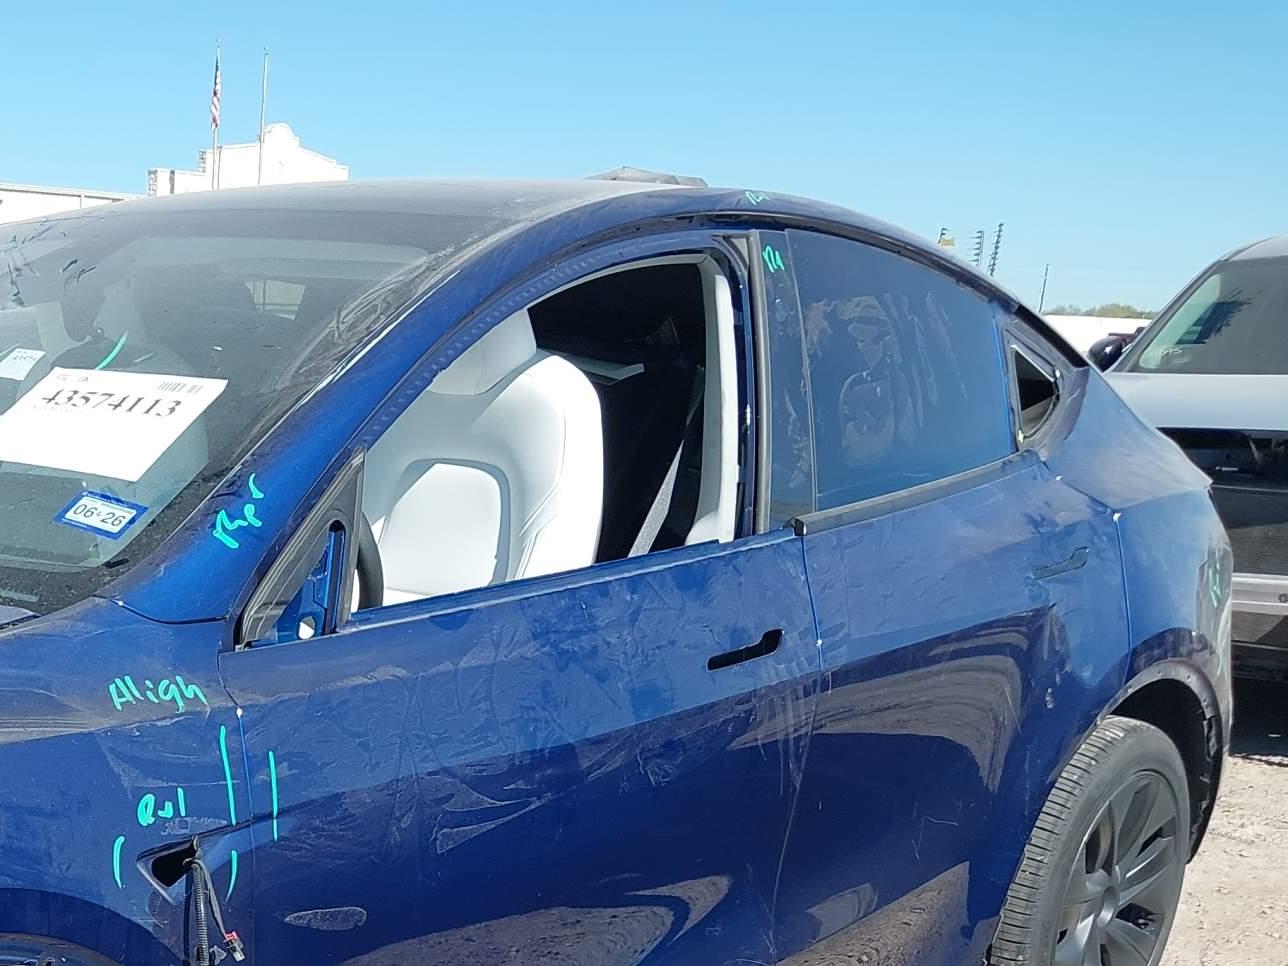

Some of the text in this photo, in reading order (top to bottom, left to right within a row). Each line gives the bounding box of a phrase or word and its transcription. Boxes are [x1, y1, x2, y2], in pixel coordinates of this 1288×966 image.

[41, 388, 182, 417] 43574113
[73, 503, 126, 527] 06 26
